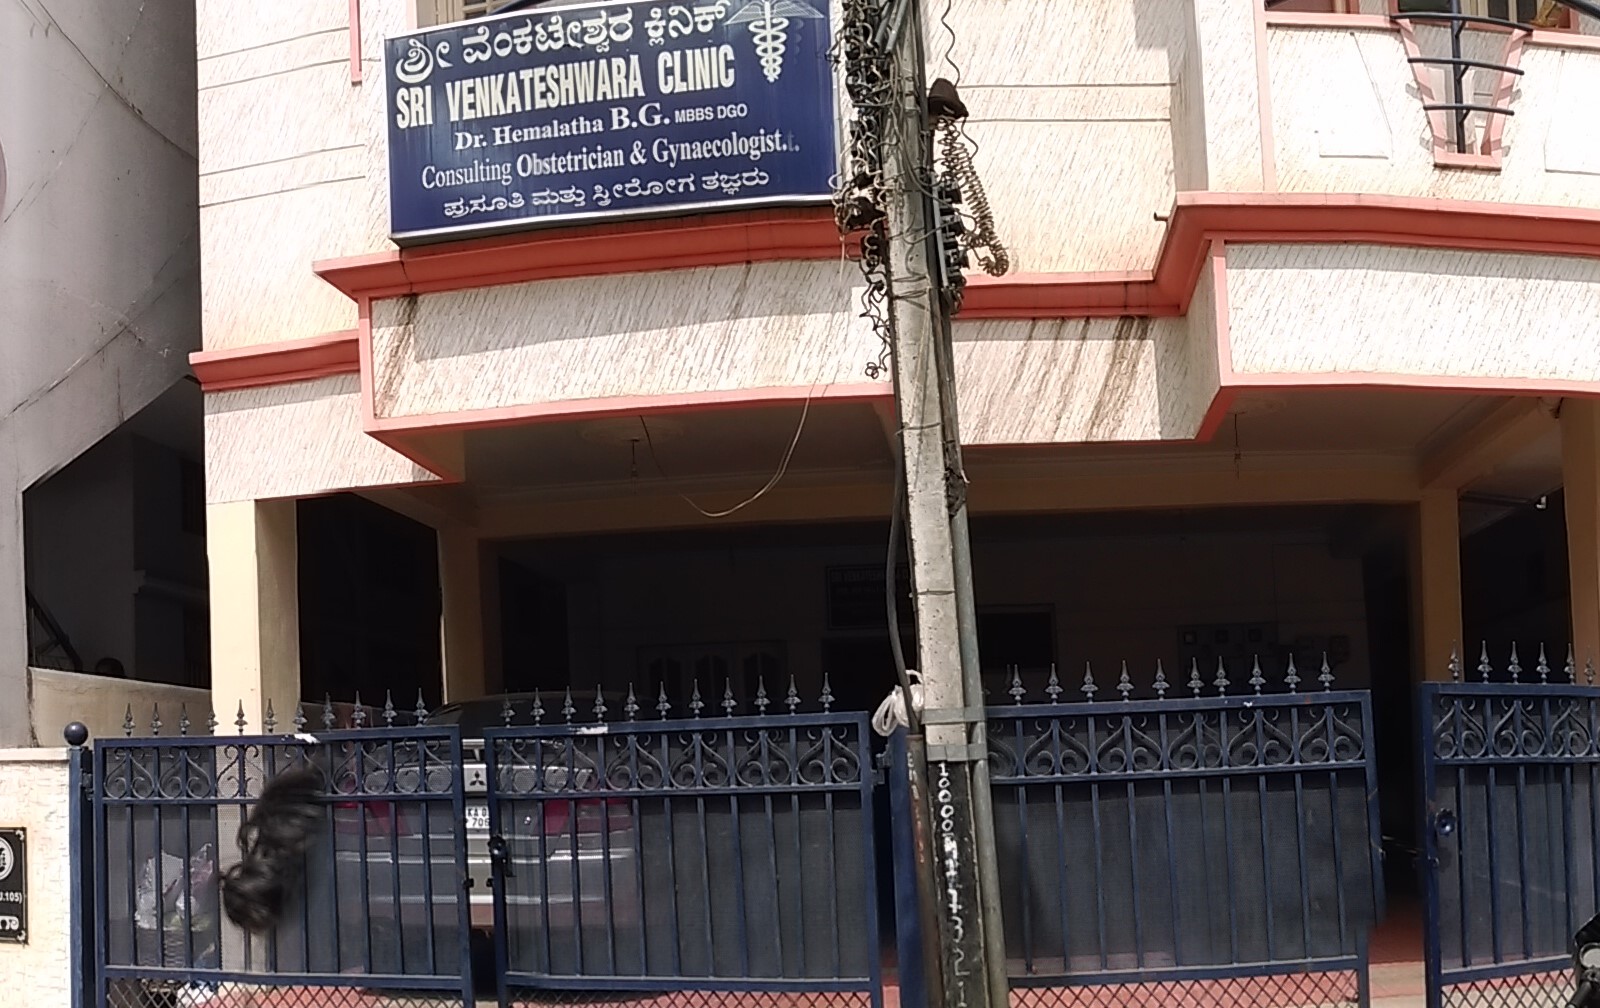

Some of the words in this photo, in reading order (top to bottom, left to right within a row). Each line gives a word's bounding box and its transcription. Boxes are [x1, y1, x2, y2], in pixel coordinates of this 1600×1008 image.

[395, 38, 453, 83] ಶ್ರೀ
[462, 7, 633, 63] ವೆಂಕಟೇಶ್ವರ
[644, 1, 731, 46] ಕ್ಲಿನಿಕ್
[395, 84, 433, 129] SRI
[446, 54, 644, 122] VENKATESHWARA
[658, 44, 735, 93] CLINIC
[454, 130, 488, 151] Dr.
[493, 115, 604, 147] Hemalatha
[610, 102, 671, 131] B.G.
[675, 107, 714, 124] MBBS
[717, 103, 748, 120] DGO
[421, 157, 513, 190] Consulting
[516, 147, 625, 179] Obstetrician
[630, 140, 647, 166] &
[443, 192, 526, 218] ಪ್ರಸೂತಿ
[531, 185, 587, 207] ಮತ್ತು
[592, 174, 696, 206] ಸ್ತ್ರೀರೋಗ
[701, 166, 770, 195] ತಜ್ಞರು
